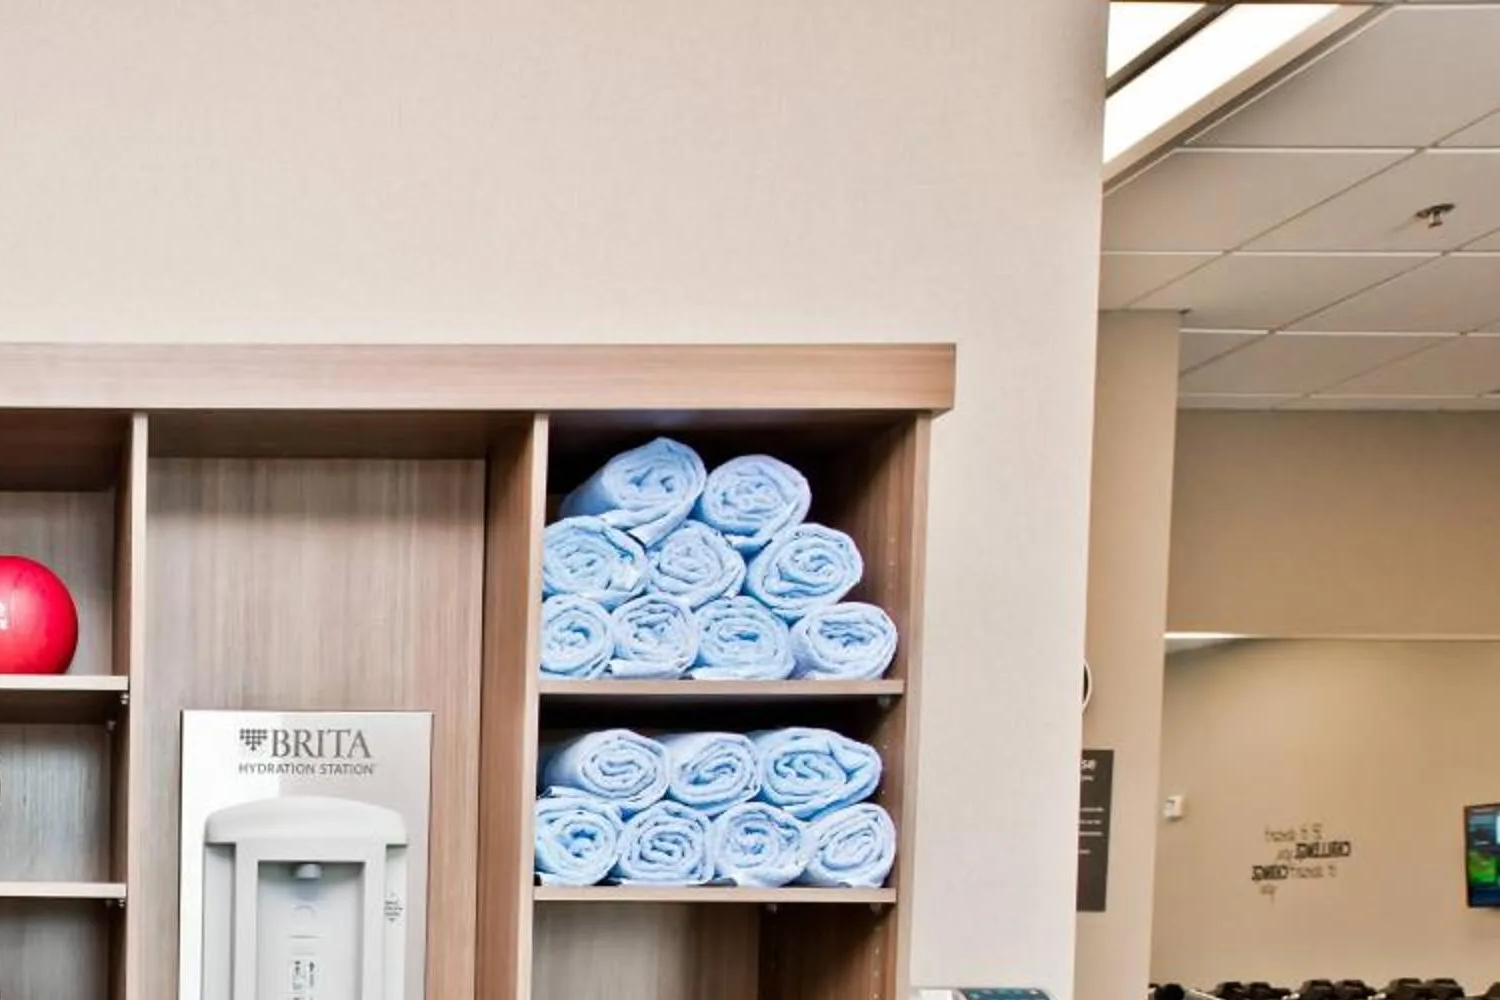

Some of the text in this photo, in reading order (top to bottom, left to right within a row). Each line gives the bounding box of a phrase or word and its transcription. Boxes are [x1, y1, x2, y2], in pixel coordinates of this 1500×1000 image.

[271, 728, 371, 759] BRITA
[238, 763, 373, 775] HYDRATION STATION
